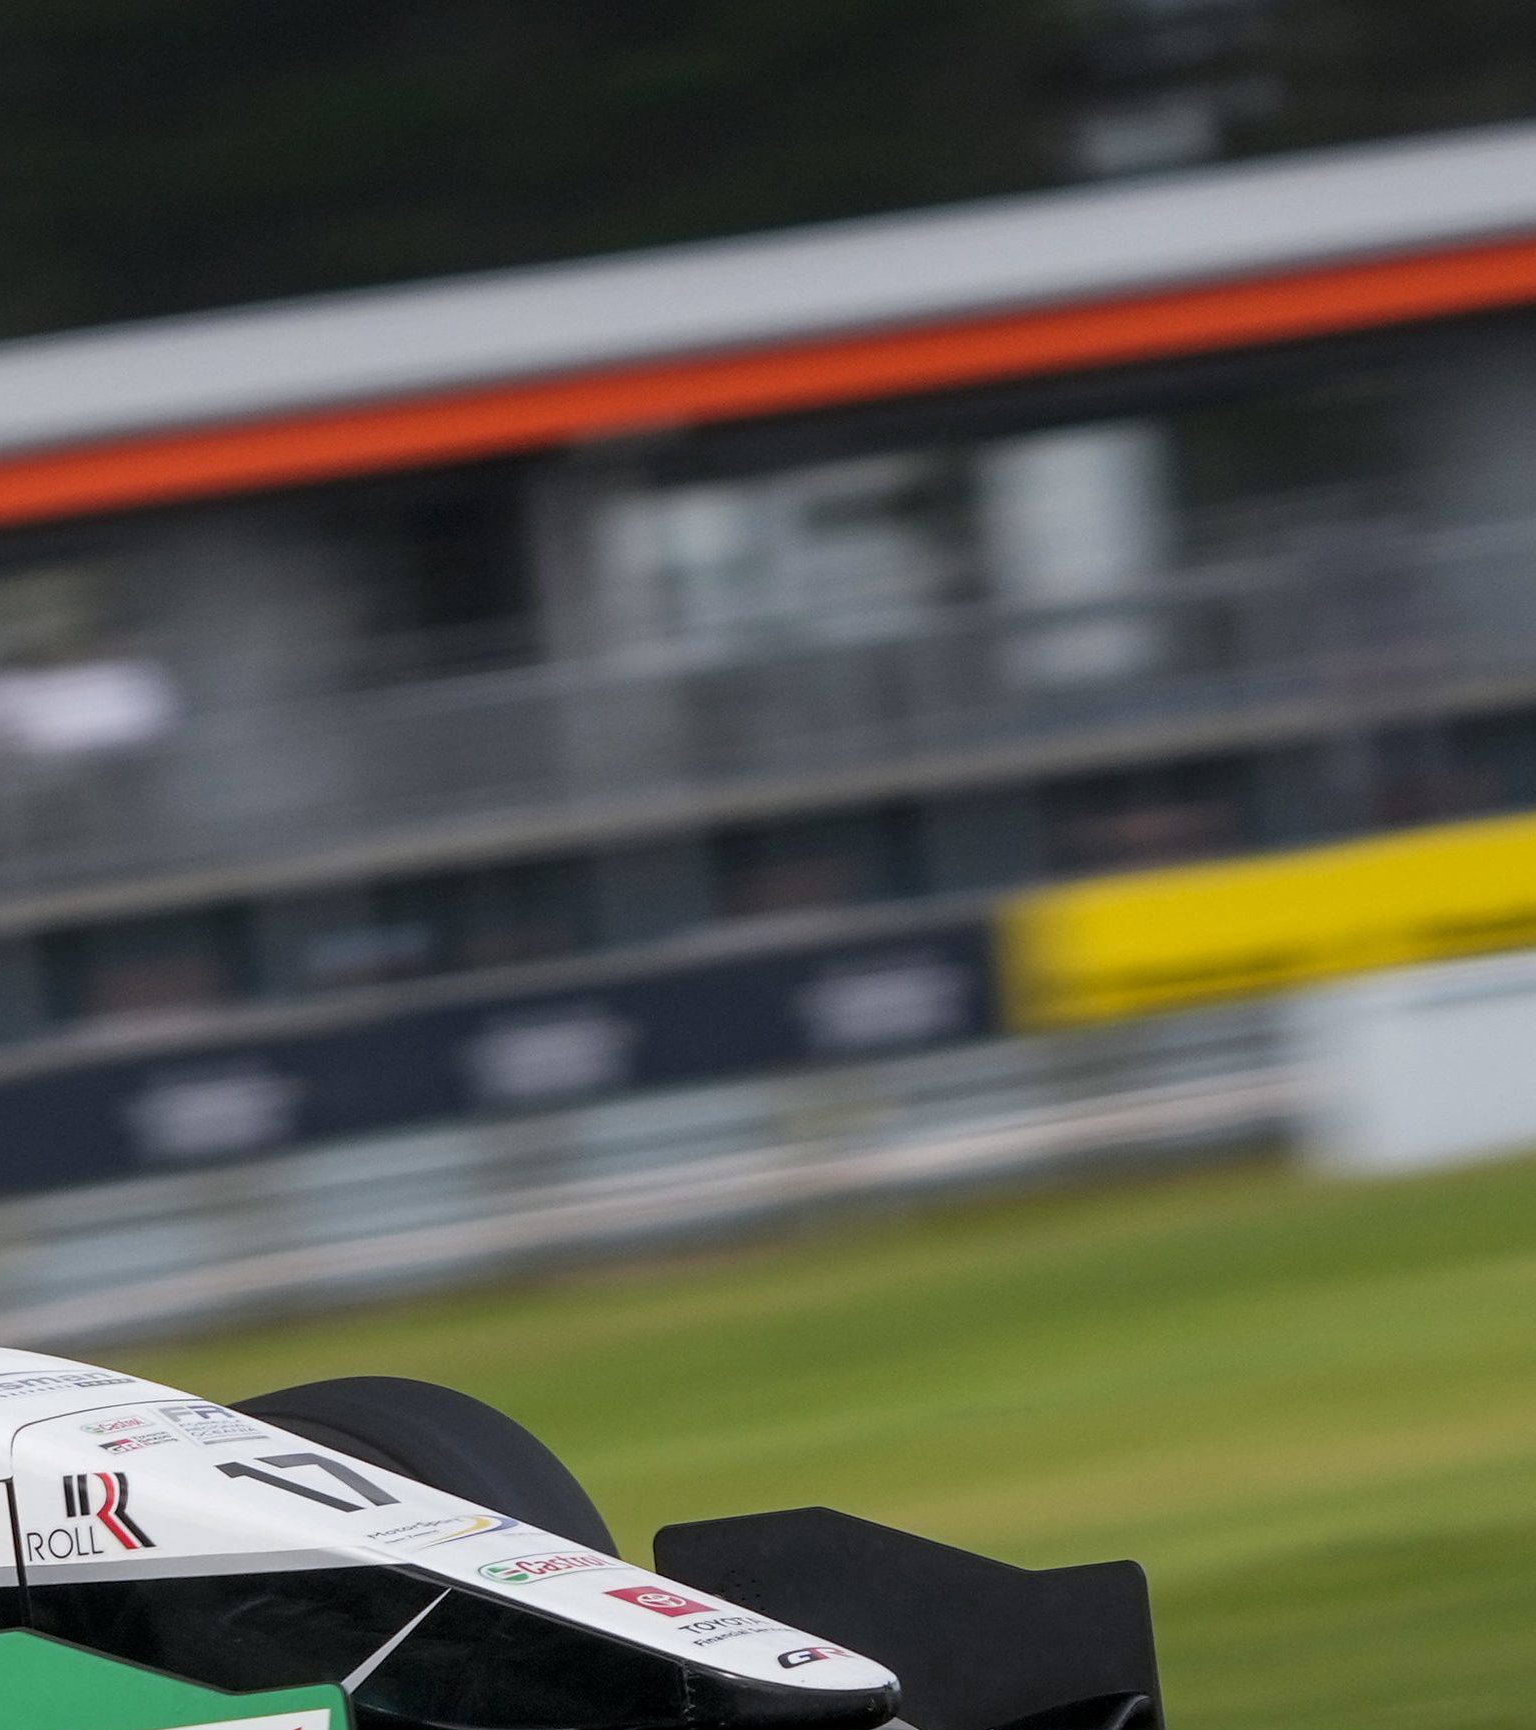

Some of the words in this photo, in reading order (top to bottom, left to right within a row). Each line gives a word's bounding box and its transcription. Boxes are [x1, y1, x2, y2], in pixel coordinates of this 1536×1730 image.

[216, 1452, 398, 1512] 17
[26, 1525, 104, 1562] ROLL
[516, 1554, 612, 1576] Castrol
[678, 1616, 763, 1635] TOYOTA
[777, 1647, 856, 1669] GR
